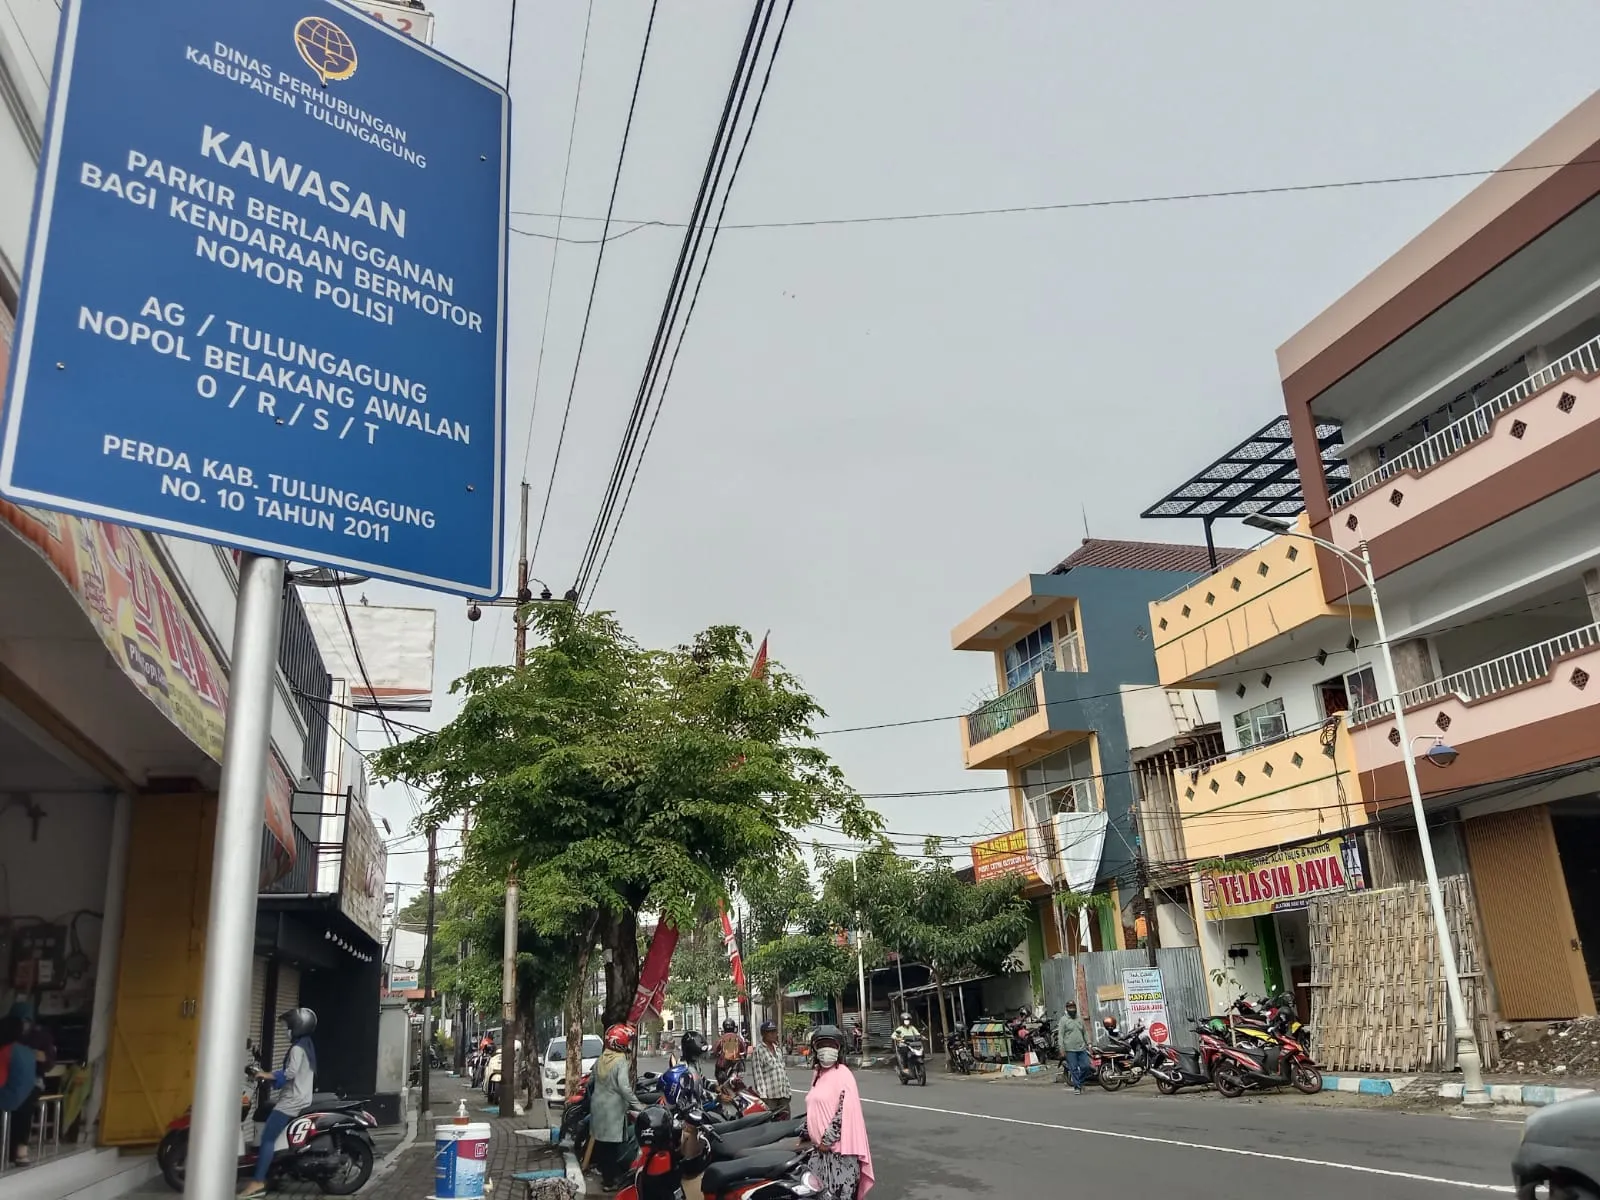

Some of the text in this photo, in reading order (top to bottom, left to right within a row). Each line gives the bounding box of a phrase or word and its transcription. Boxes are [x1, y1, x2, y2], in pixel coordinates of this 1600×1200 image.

[186, 46, 426, 169] KABUPATEN TULUNGAGUNG
[214, 41, 406, 143] DINAS PERHUBUNGAN
[127, 150, 453, 296] PARKIR BERLANGGANAN
[201, 125, 406, 238] KAWASAN
[80, 162, 482, 333] BAGI KENDARAAN BERMOTOR
[196, 235, 393, 325] NOMOR POLISI
[79, 306, 470, 444] NOPOL BELAKANG AWALAN
[140, 296, 427, 404] AG / TULUNGAGUNG
[228, 385, 246, 408] /
[258, 391, 276, 417] R
[288, 403, 305, 426] /
[313, 408, 329, 431] S
[339, 417, 355, 439] /
[364, 422, 379, 444] T
[103, 434, 435, 529] PERDA KAB. TULUNGAGUNG
[161, 474, 389, 543] NO. 10 TAHUN 2011
[1219, 865, 1294, 904] TELASIH
[1295, 855, 1345, 893] JAYA
